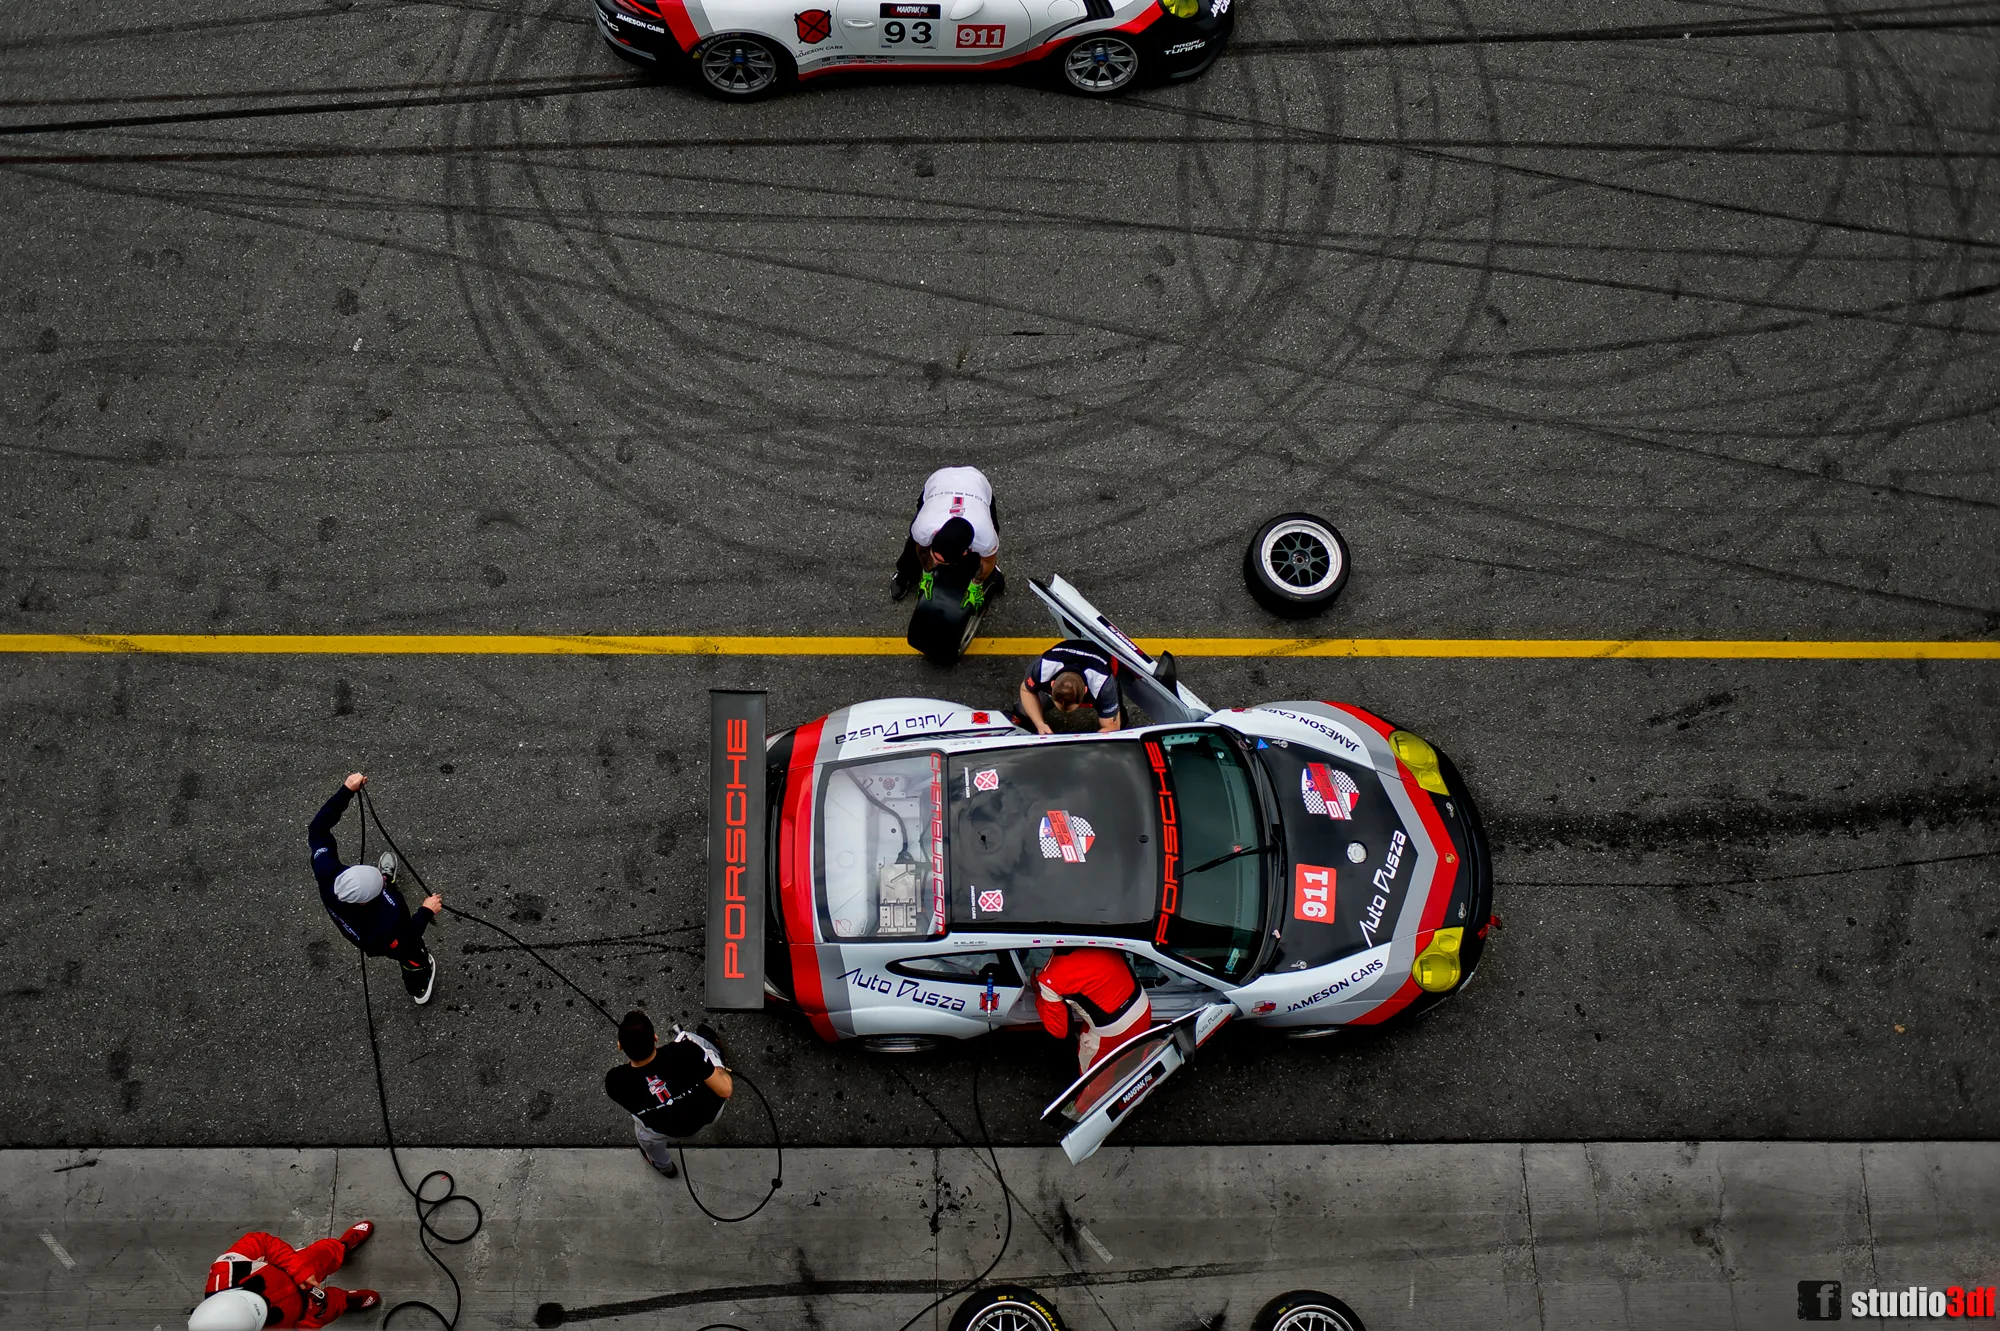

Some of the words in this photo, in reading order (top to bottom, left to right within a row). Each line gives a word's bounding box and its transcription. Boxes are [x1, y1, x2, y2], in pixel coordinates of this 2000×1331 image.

[616, 12, 647, 29] JAMESON
[647, 23, 665, 34] CARS
[884, 21, 932, 44] 93
[959, 28, 1002, 46] 911
[1164, 41, 1206, 55] TUNING
[795, 46, 824, 59] JAMESON
[1052, 647, 1108, 666] PORSCHE
[905, 711, 955, 730] Auto
[1260, 707, 1297, 720] CARS
[835, 722, 900, 746] Dusza
[1299, 716, 1360, 752] JAMESON
[724, 719, 747, 979] PORSCHE
[1145, 741, 1179, 945] PORSCHE
[1302, 870, 1328, 918] 911
[1359, 894, 1387, 949] Auto
[1373, 829, 1407, 894] Dusza
[836, 967, 893, 995] Auto
[896, 978, 966, 1012] Dusza
[1286, 977, 1350, 1013] JAMESON
[1350, 958, 1384, 983] CARS
